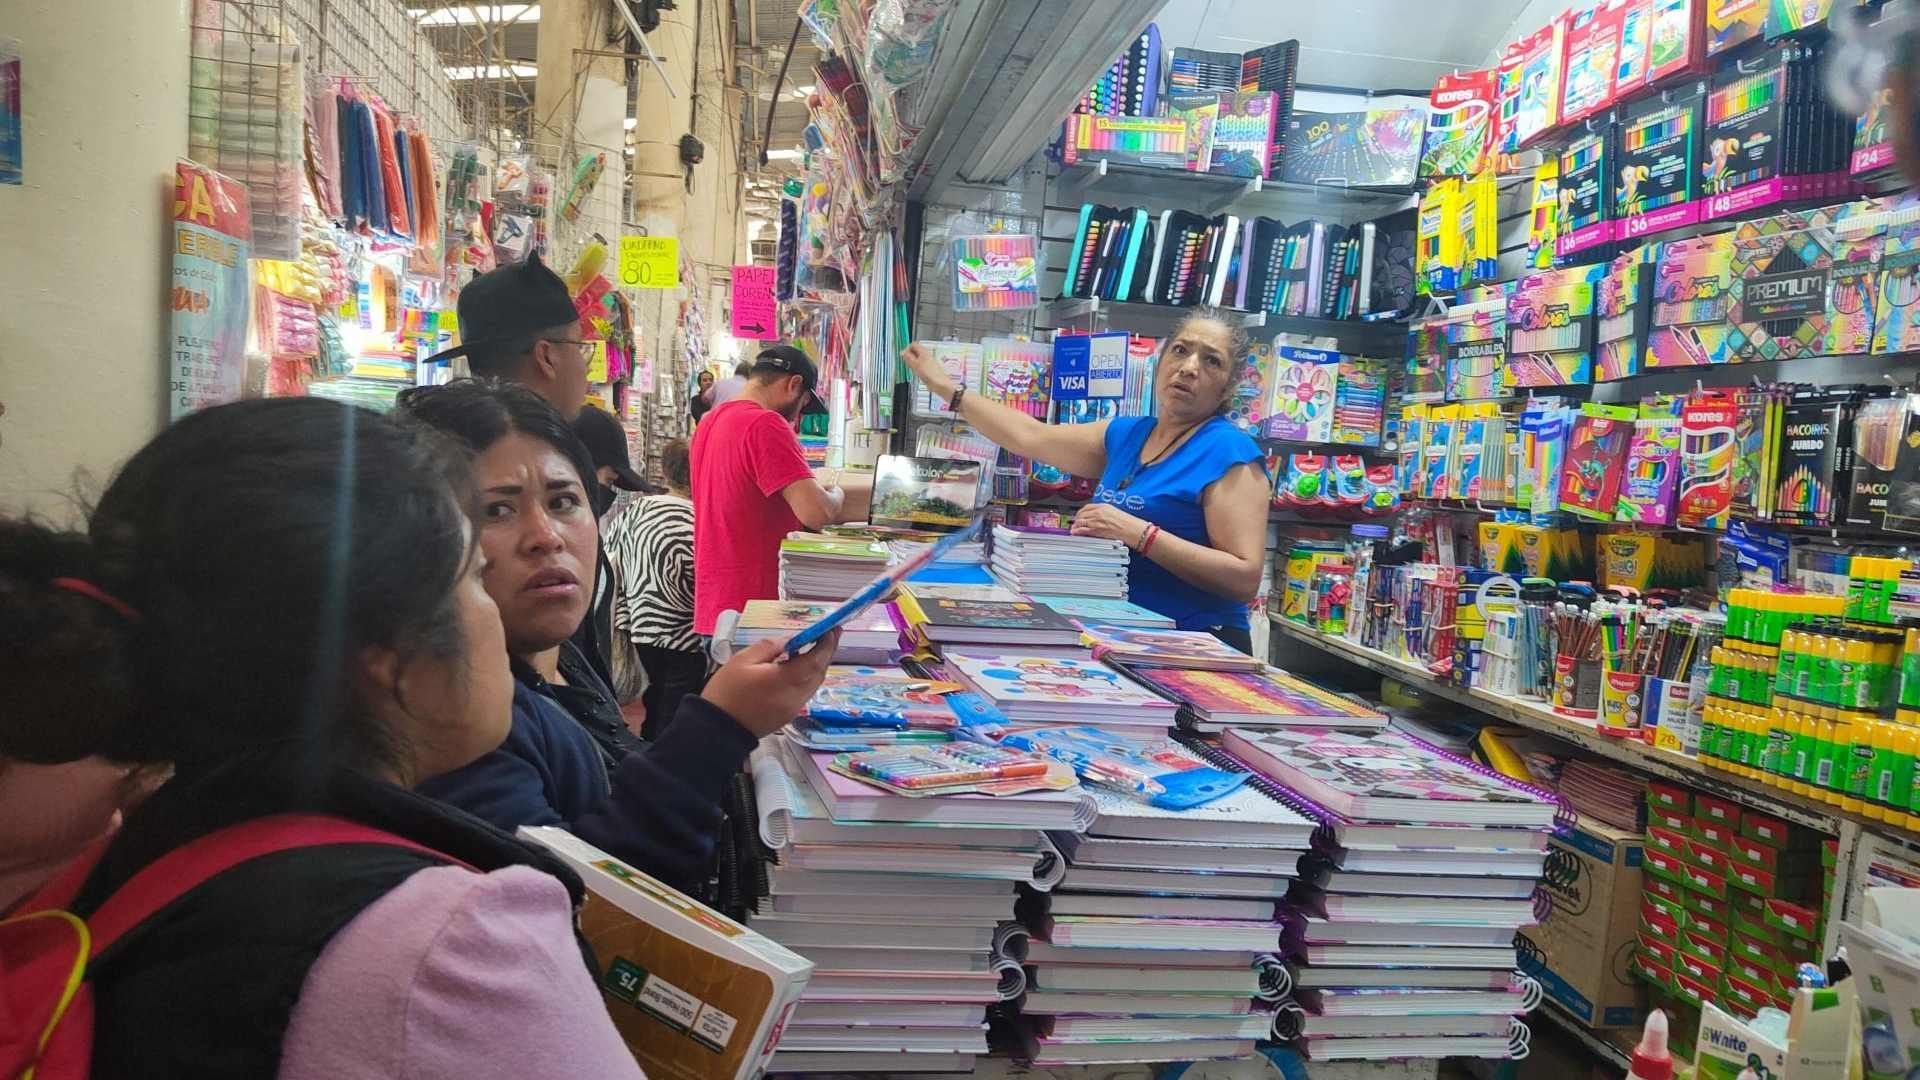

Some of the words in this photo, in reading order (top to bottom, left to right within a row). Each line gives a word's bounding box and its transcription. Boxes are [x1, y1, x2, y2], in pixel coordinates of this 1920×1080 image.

[1717, 105, 1770, 129] PRISMACOLOR
[1305, 120, 1330, 141] 100
[1859, 151, 1879, 166] 24
[1714, 196, 1731, 213] 48
[1631, 217, 1648, 233] 36
[1564, 237, 1576, 251] 36
[623, 260, 651, 285] 80
[1746, 275, 1823, 301] PREMIUM
[1457, 342, 1505, 359] BORRABLES
[1092, 353, 1122, 369] OPEN
[1058, 375, 1086, 391] VISA
[1790, 440, 1825, 450] JUMBO
[619, 971, 640, 992] 75
